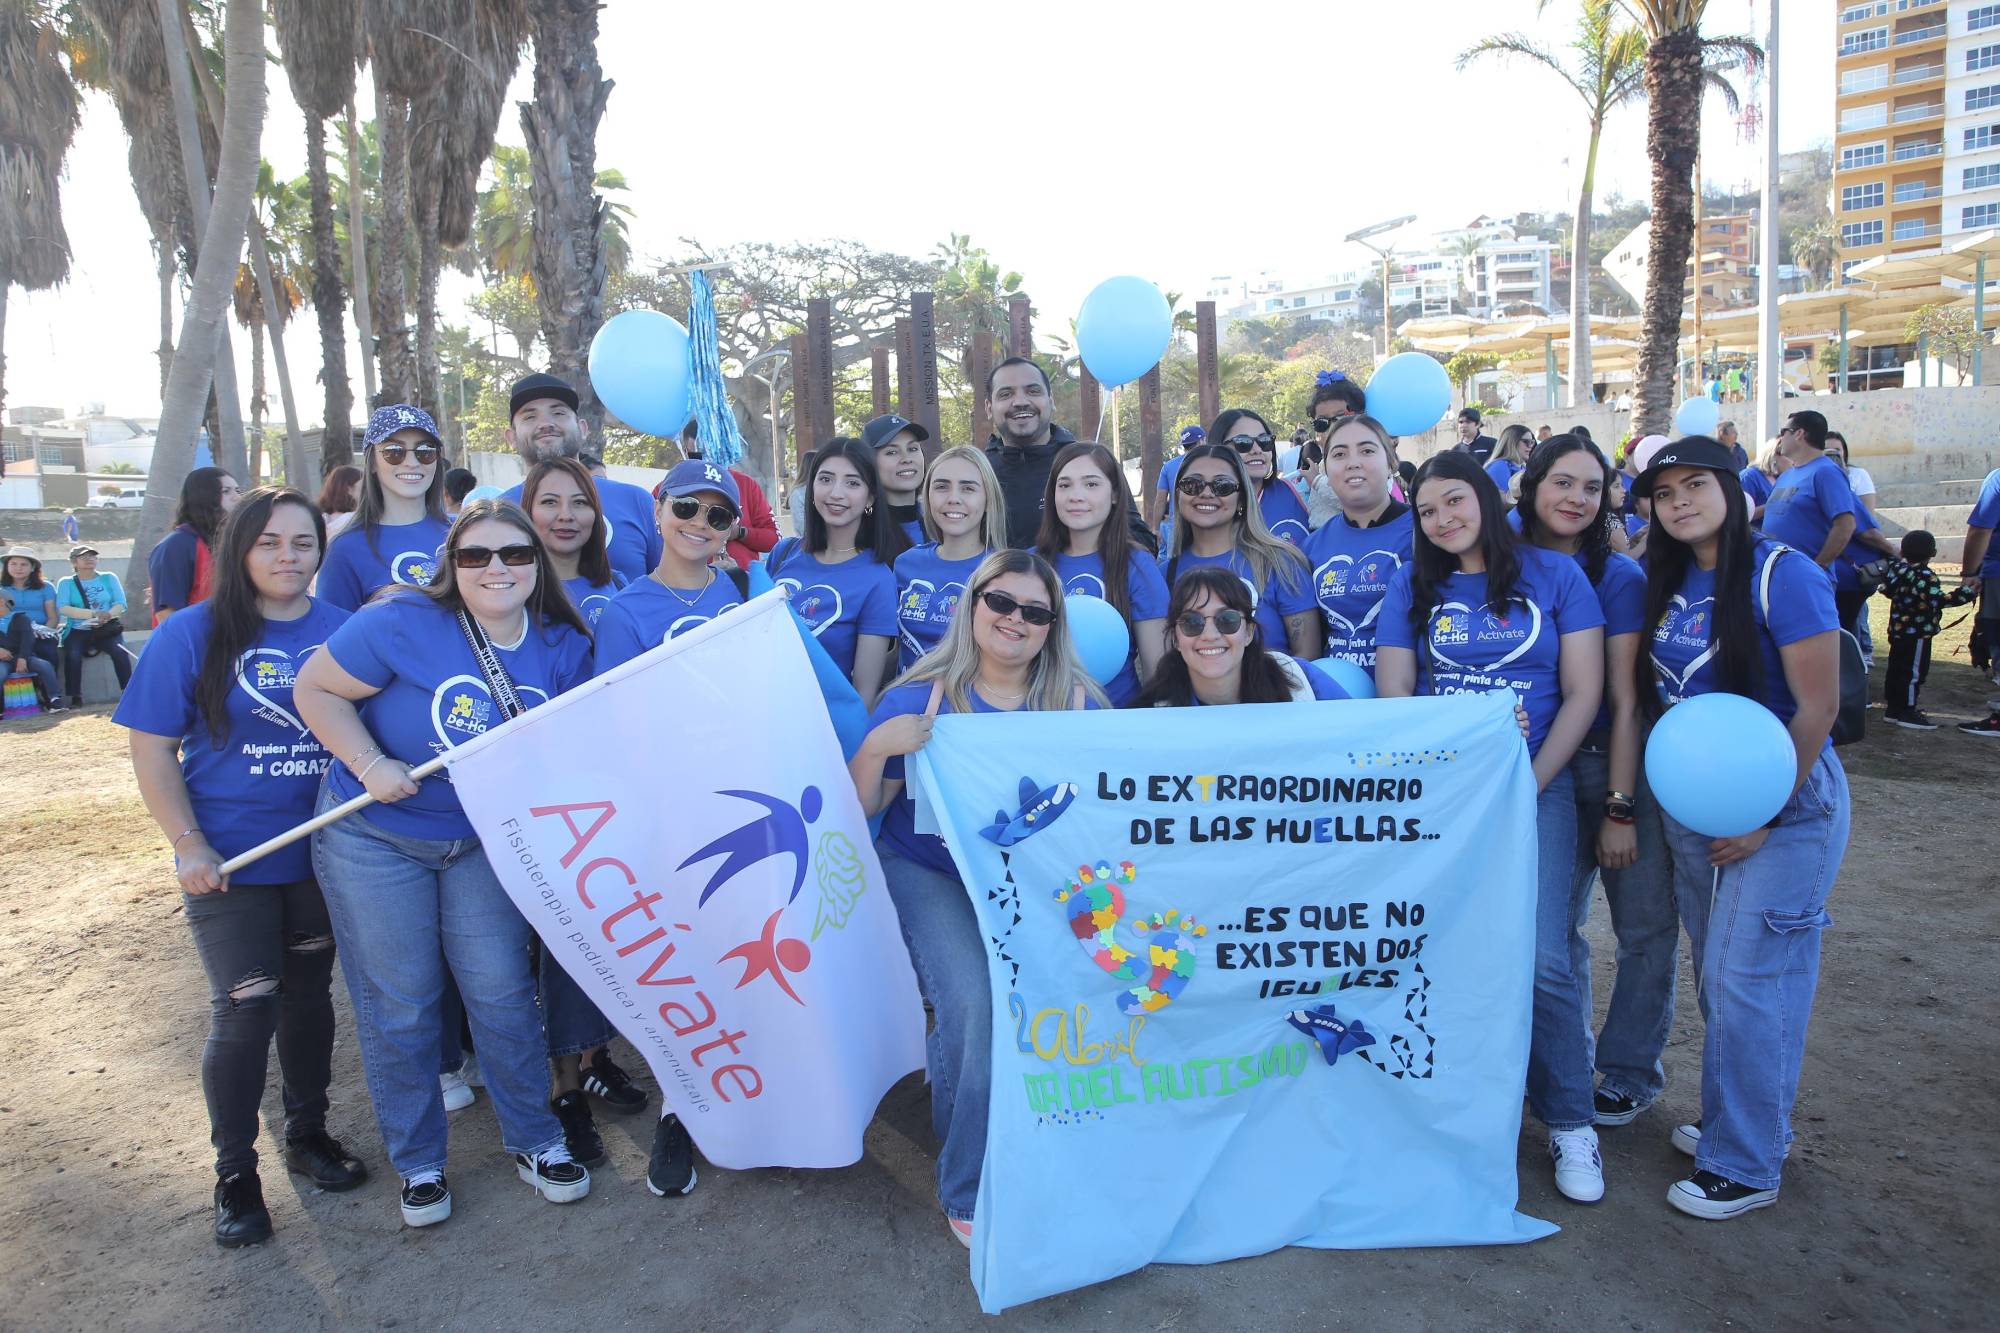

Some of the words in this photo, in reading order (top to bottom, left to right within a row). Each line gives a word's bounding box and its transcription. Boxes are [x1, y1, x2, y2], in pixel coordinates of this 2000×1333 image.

[921, 310, 931, 338] EUA
[922, 342, 932, 358] TX
[923, 360, 936, 405] MISSION
[397, 410, 417, 424] LA
[704, 463, 722, 483] LA
[1434, 632, 1468, 643] De-Ha
[1336, 652, 1377, 666] CORAZ
[480, 647, 498, 676] STEVE
[492, 673, 514, 705] MADDEN
[1463, 673, 1491, 685] pinta
[1494, 677, 1507, 686] de
[1511, 680, 1532, 690] azul
[252, 706, 290, 728] Autismo
[446, 713, 487, 734] De-Ha
[242, 743, 287, 759] Alguien
[292, 742, 320, 757] pinta
[250, 763, 263, 775] mi
[270, 758, 335, 776] CORAZ
[1147, 774, 1422, 803] EXTRAORDINARIO
[1130, 818, 1175, 845] DE
[1190, 816, 1256, 842] LAS
[1266, 816, 1440, 843] HUELLAS...
[1300, 903, 1369, 931] QUE
[1385, 901, 1425, 928] NO
[500, 817, 572, 926] Fisioterapia
[567, 932, 634, 1008] pediátrica
[630, 1012, 647, 1025] y
[645, 1026, 710, 1113] aprendizaje
[529, 800, 763, 1103] Actívate
[1216, 940, 1367, 969] EXISTEN
[1376, 934, 1428, 964] DOS
[1009, 991, 1035, 1055] 2
[1067, 1066, 1136, 1111] DEL
[1141, 1041, 1308, 1105] AUTISMO
